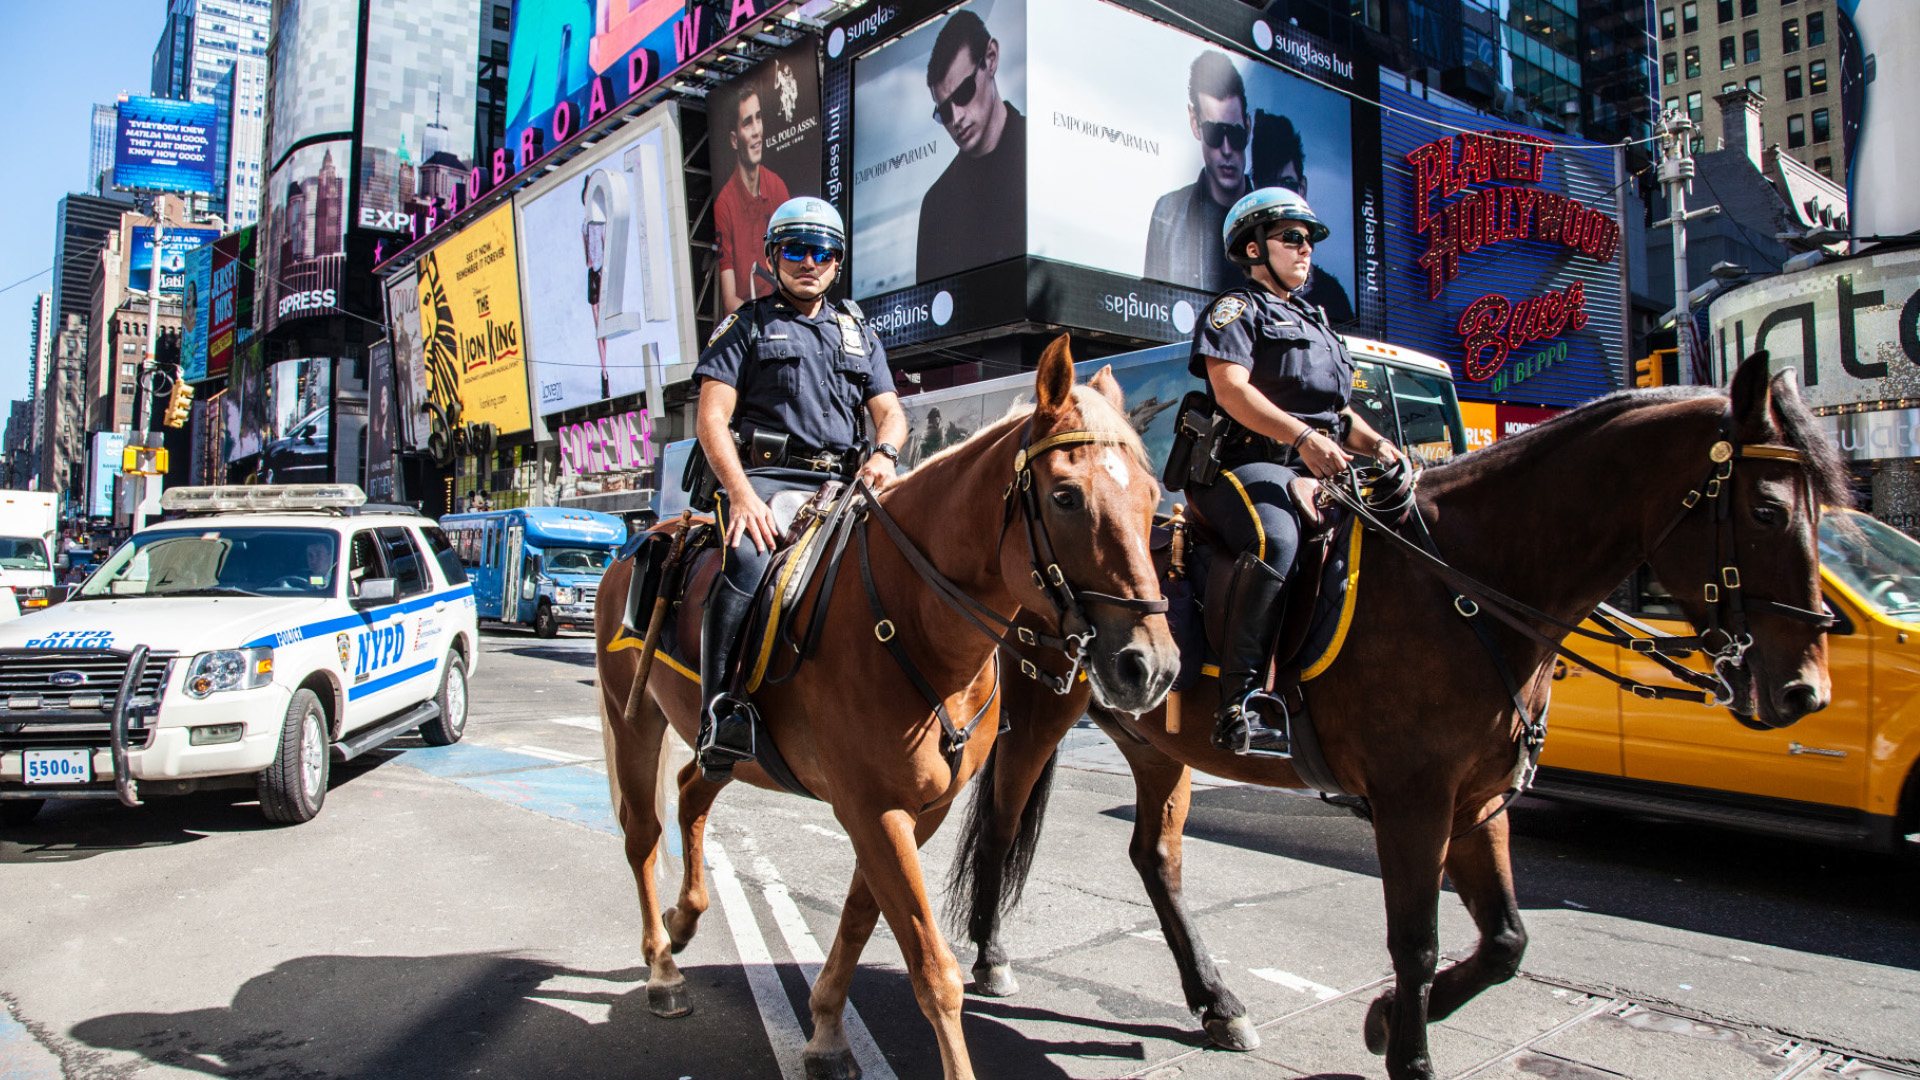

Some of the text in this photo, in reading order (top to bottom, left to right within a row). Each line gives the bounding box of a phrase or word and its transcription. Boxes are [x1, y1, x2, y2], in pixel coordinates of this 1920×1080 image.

[1275, 34, 1354, 80] sunglass hut
[125, 129, 209, 146] MATILDA WAS GOOD,
[180, 126, 206, 135] KNEW
[766, 135, 778, 148] U.S.
[778, 126, 797, 142] POLO
[827, 103, 841, 141] hut
[1053, 111, 1160, 156] EMPORIO ARMANI
[128, 147, 155, 156] KNOW
[156, 150, 178, 159] HOW
[130, 138, 203, 153] THEY JUST DIDN'T
[855, 140, 937, 186] EMPORIO ARMANI
[1407, 131, 1555, 234] PLANET
[1418, 186, 1620, 299] HOLLYWOOD
[211, 257, 239, 300] JERSEY
[1366, 259, 1379, 293] hut
[215, 291, 233, 326] BOYS
[279, 289, 337, 318] EXPRESS
[476, 294, 490, 314] THE
[459, 332, 486, 375] LION
[486, 319, 517, 365] KING
[1514, 341, 1567, 383] BEPPO
[559, 409, 655, 477] FOREVER
[1464, 427, 1492, 447] RL'S
[25, 638, 116, 649] POLICE
[47, 630, 112, 639] NYPD
[276, 627, 302, 647] POLICE
[355, 622, 405, 676] NYPD
[29, 759, 69, 777] 5500
